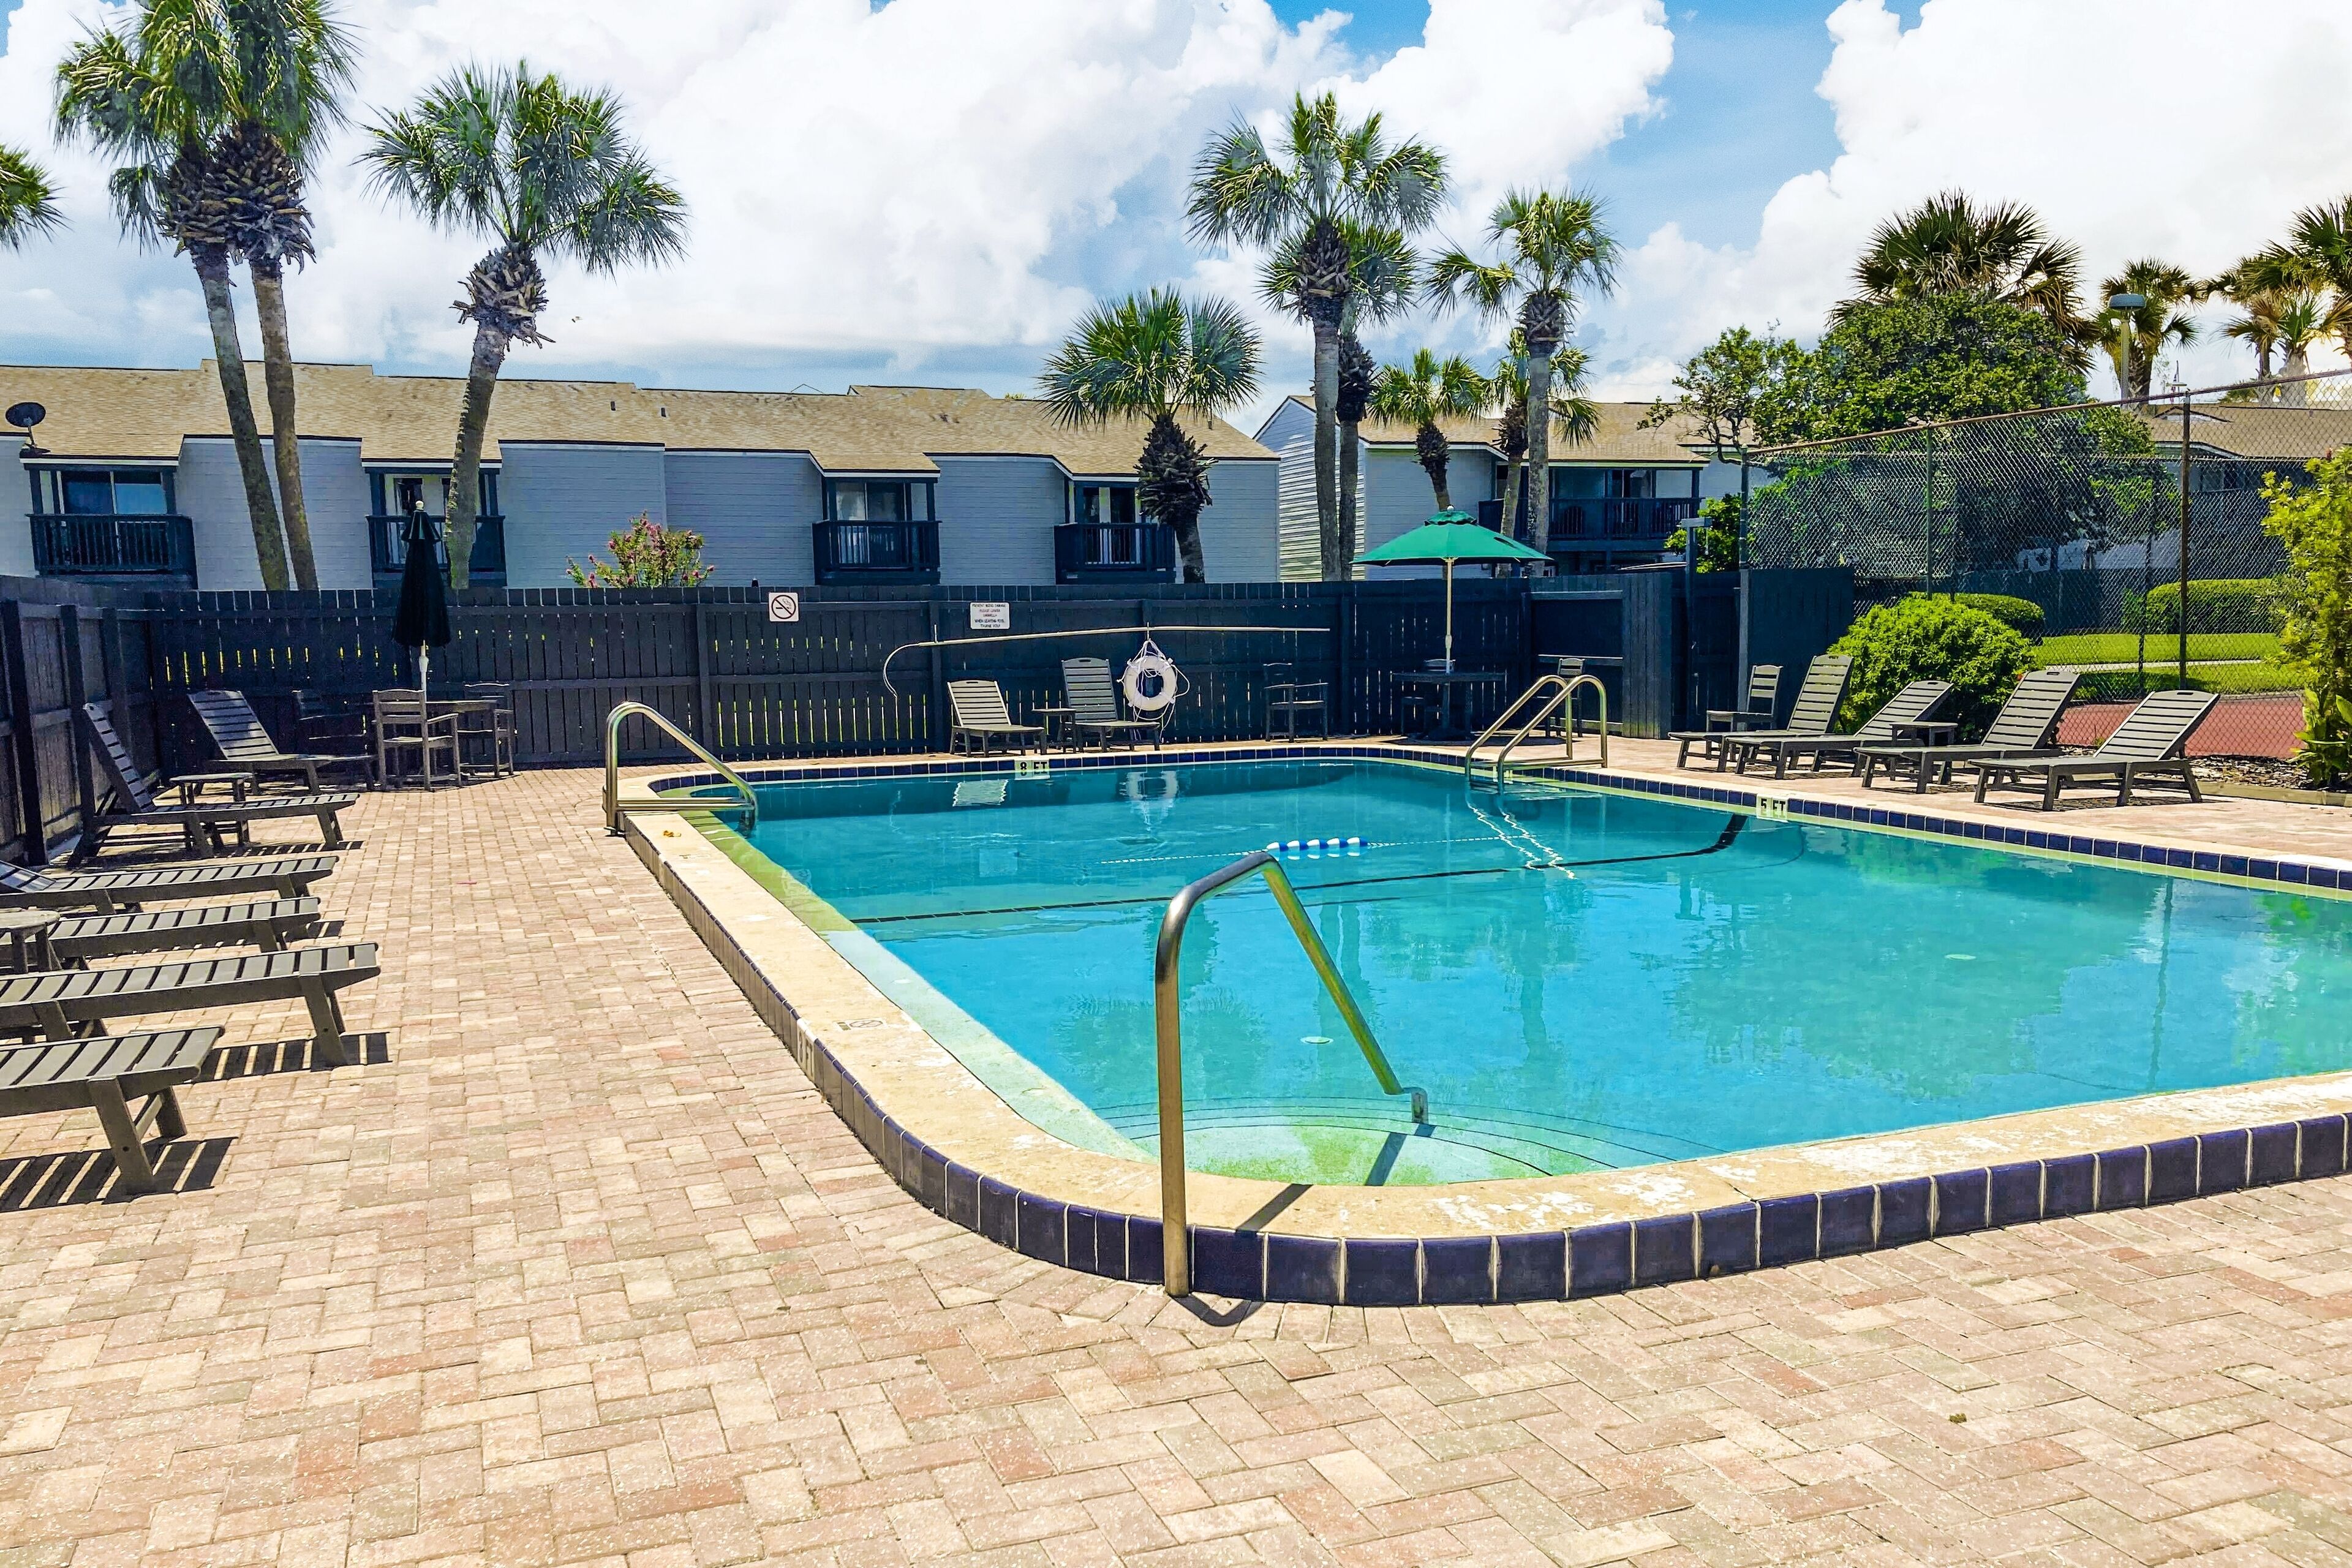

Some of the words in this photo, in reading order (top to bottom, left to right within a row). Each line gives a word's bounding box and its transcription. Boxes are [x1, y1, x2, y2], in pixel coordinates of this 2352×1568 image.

[1020, 761, 1027, 770] 8
[1760, 798, 1767, 809] 5
[1773, 799, 1786, 812] FT
[805, 1038, 813, 1077] FT
